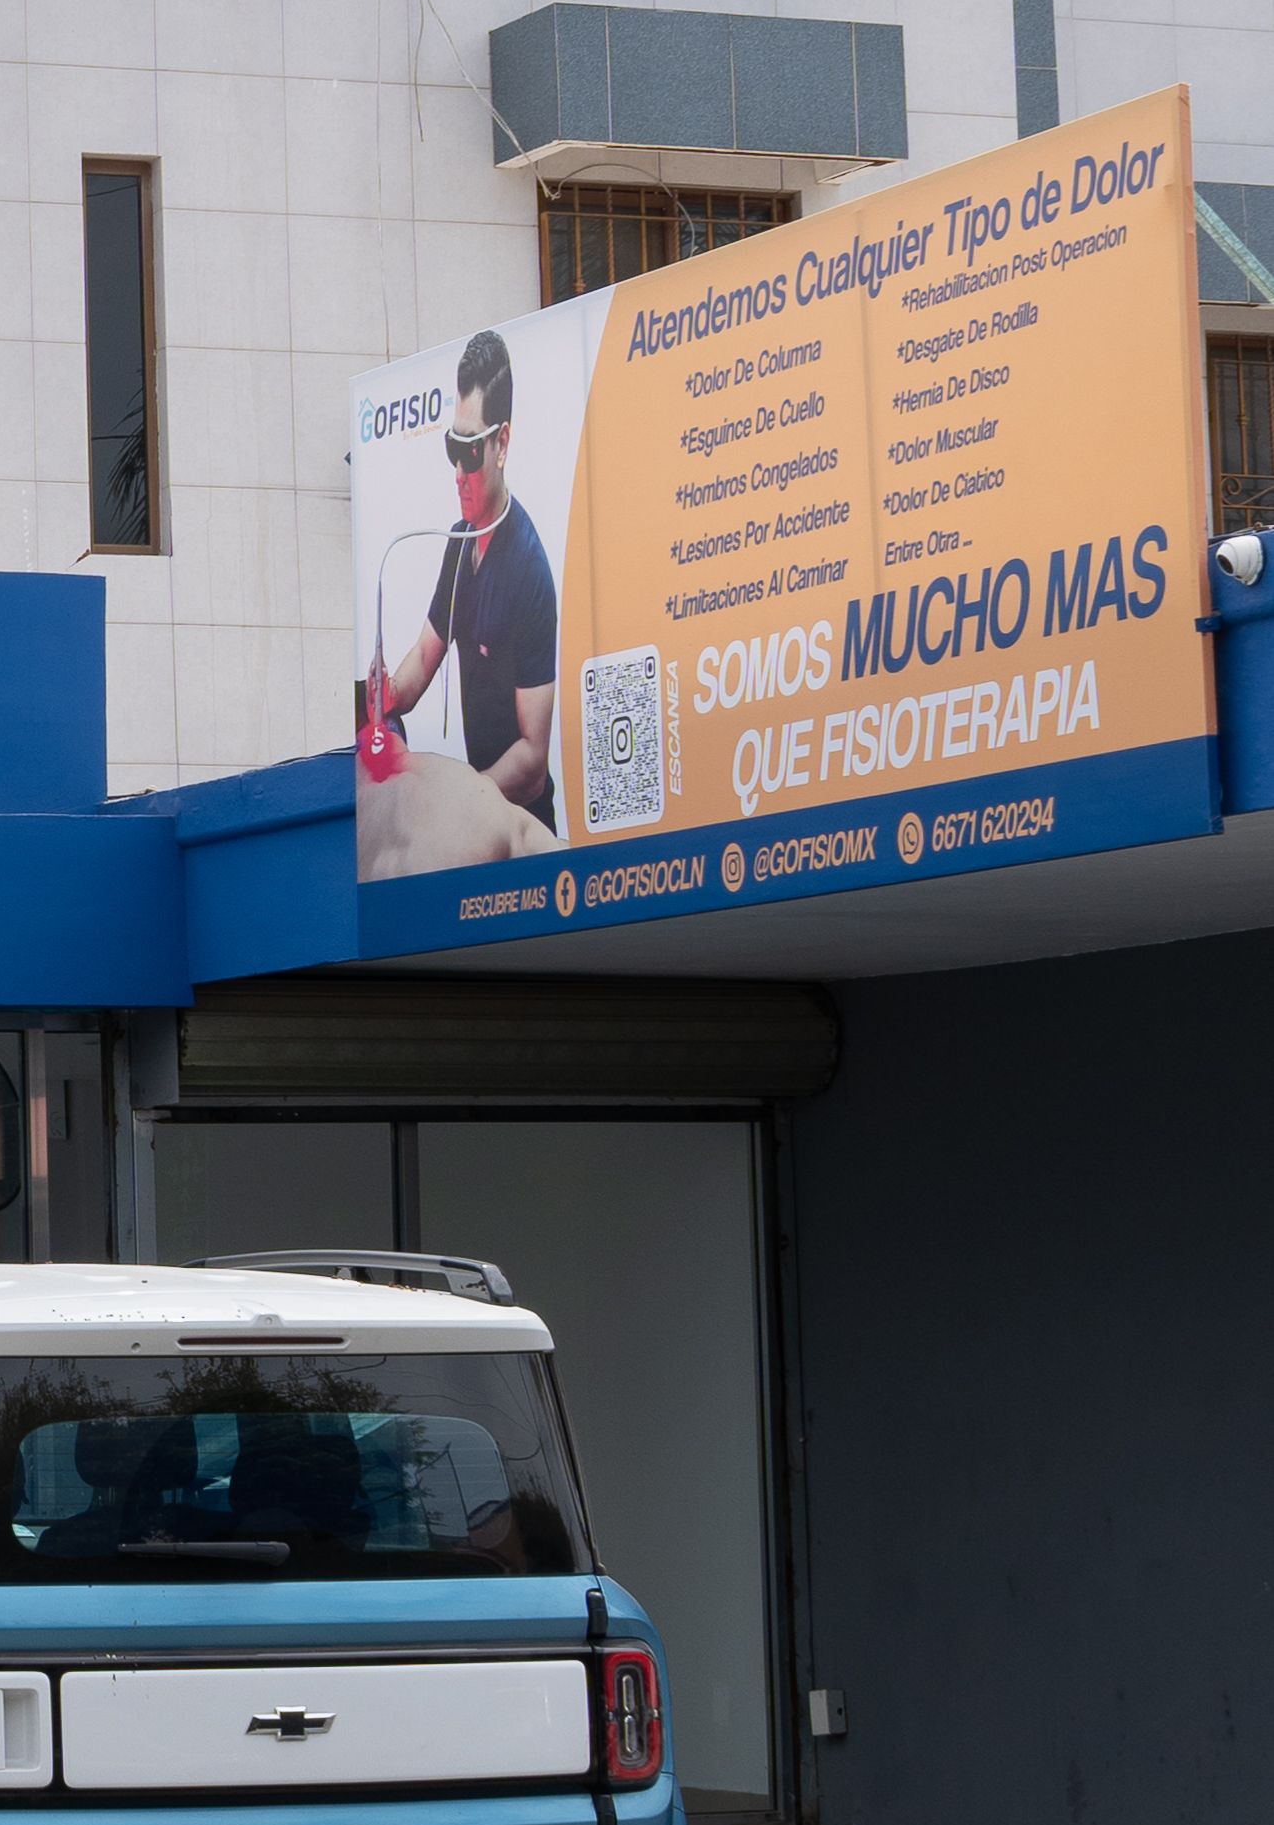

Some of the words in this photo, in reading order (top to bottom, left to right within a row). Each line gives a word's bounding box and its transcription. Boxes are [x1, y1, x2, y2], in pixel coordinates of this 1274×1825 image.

[627, 274, 786, 362] Atendemos
[796, 220, 934, 306] Cualquier
[944, 196, 1011, 267] Tipo
[1021, 171, 1061, 230] de
[1070, 141, 1165, 215] Dolor
[1011, 248, 1047, 279] Post
[1051, 224, 1127, 271] Operacion
[967, 319, 987, 344] De
[990, 301, 1038, 337] Rodilla
[734, 358, 753, 385] De
[758, 340, 821, 378] Columna
[947, 376, 966, 401] De
[969, 365, 1010, 394] Disco
[360, 388, 442, 444] GOFISIO
[755, 407, 775, 434] De
[779, 391, 825, 427] Cuello
[935, 417, 999, 454] Muscular
[751, 446, 839, 492] Congelados
[930, 480, 950, 505] De
[954, 467, 1005, 499] Ciatico
[744, 521, 770, 548] Por
[773, 499, 850, 541] Accidente
[884, 540, 923, 566] Entre
[927, 530, 960, 556] Otra
[767, 568, 784, 598] Al
[787, 558, 849, 593] Caminar
[693, 620, 833, 715] SOMOS
[840, 557, 1031, 681] MUCHO
[1042, 524, 1168, 637] MAS
[666, 660, 682, 796] ESCANEA
[732, 719, 814, 817] QUE
[820, 659, 1100, 781] FISIOTERAPIA
[754, 826, 878, 882] @GOFISIOMX
[459, 891, 519, 921] DESCUBRE
[519, 886, 547, 911] MAS
[584, 855, 706, 907] @GOFISIOCLN
